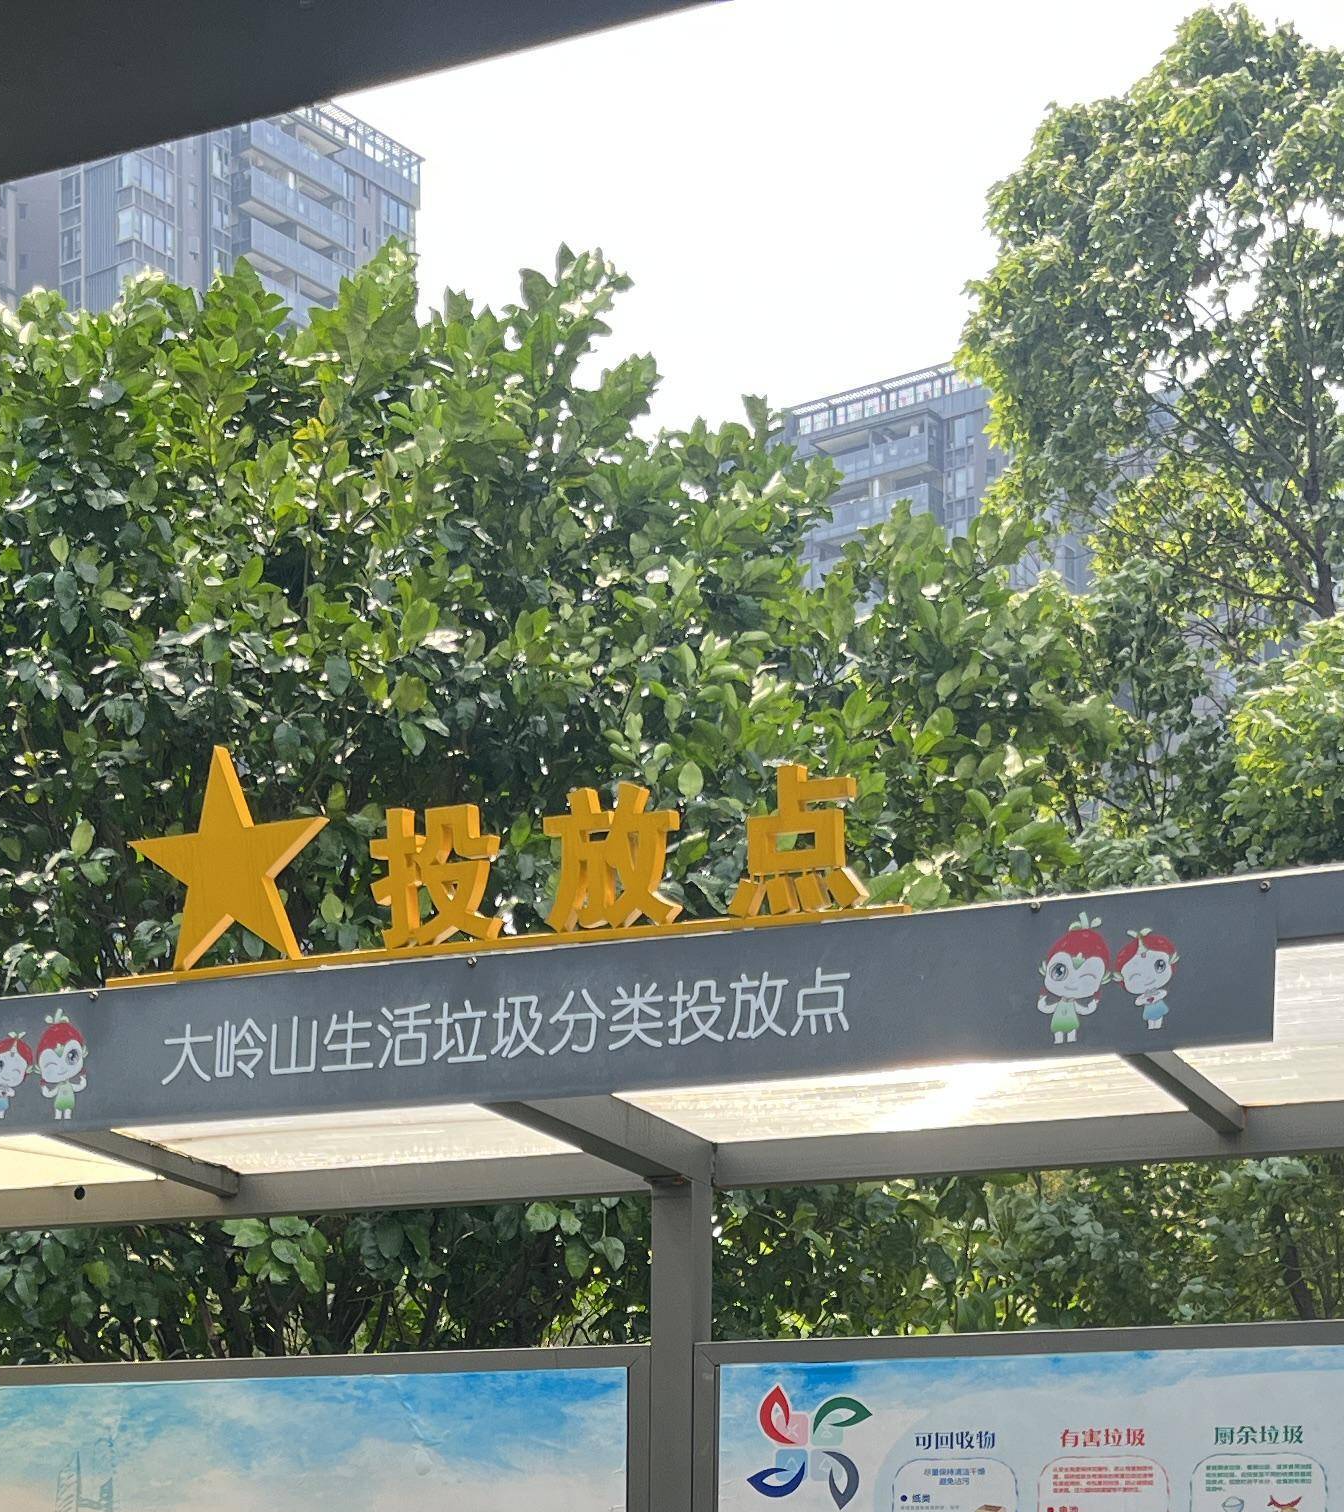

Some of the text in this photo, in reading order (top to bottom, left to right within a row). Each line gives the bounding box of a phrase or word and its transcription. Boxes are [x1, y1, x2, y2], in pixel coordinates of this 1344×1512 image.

[370, 763, 869, 949] 投放点
[162, 968, 853, 1087] 大岭山生活垃圾分类投放点
[915, 1430, 996, 1450] 可回收物
[1060, 1428, 1145, 1447] 有害垃圾
[1214, 1424, 1304, 1445] 厨余垃圾
